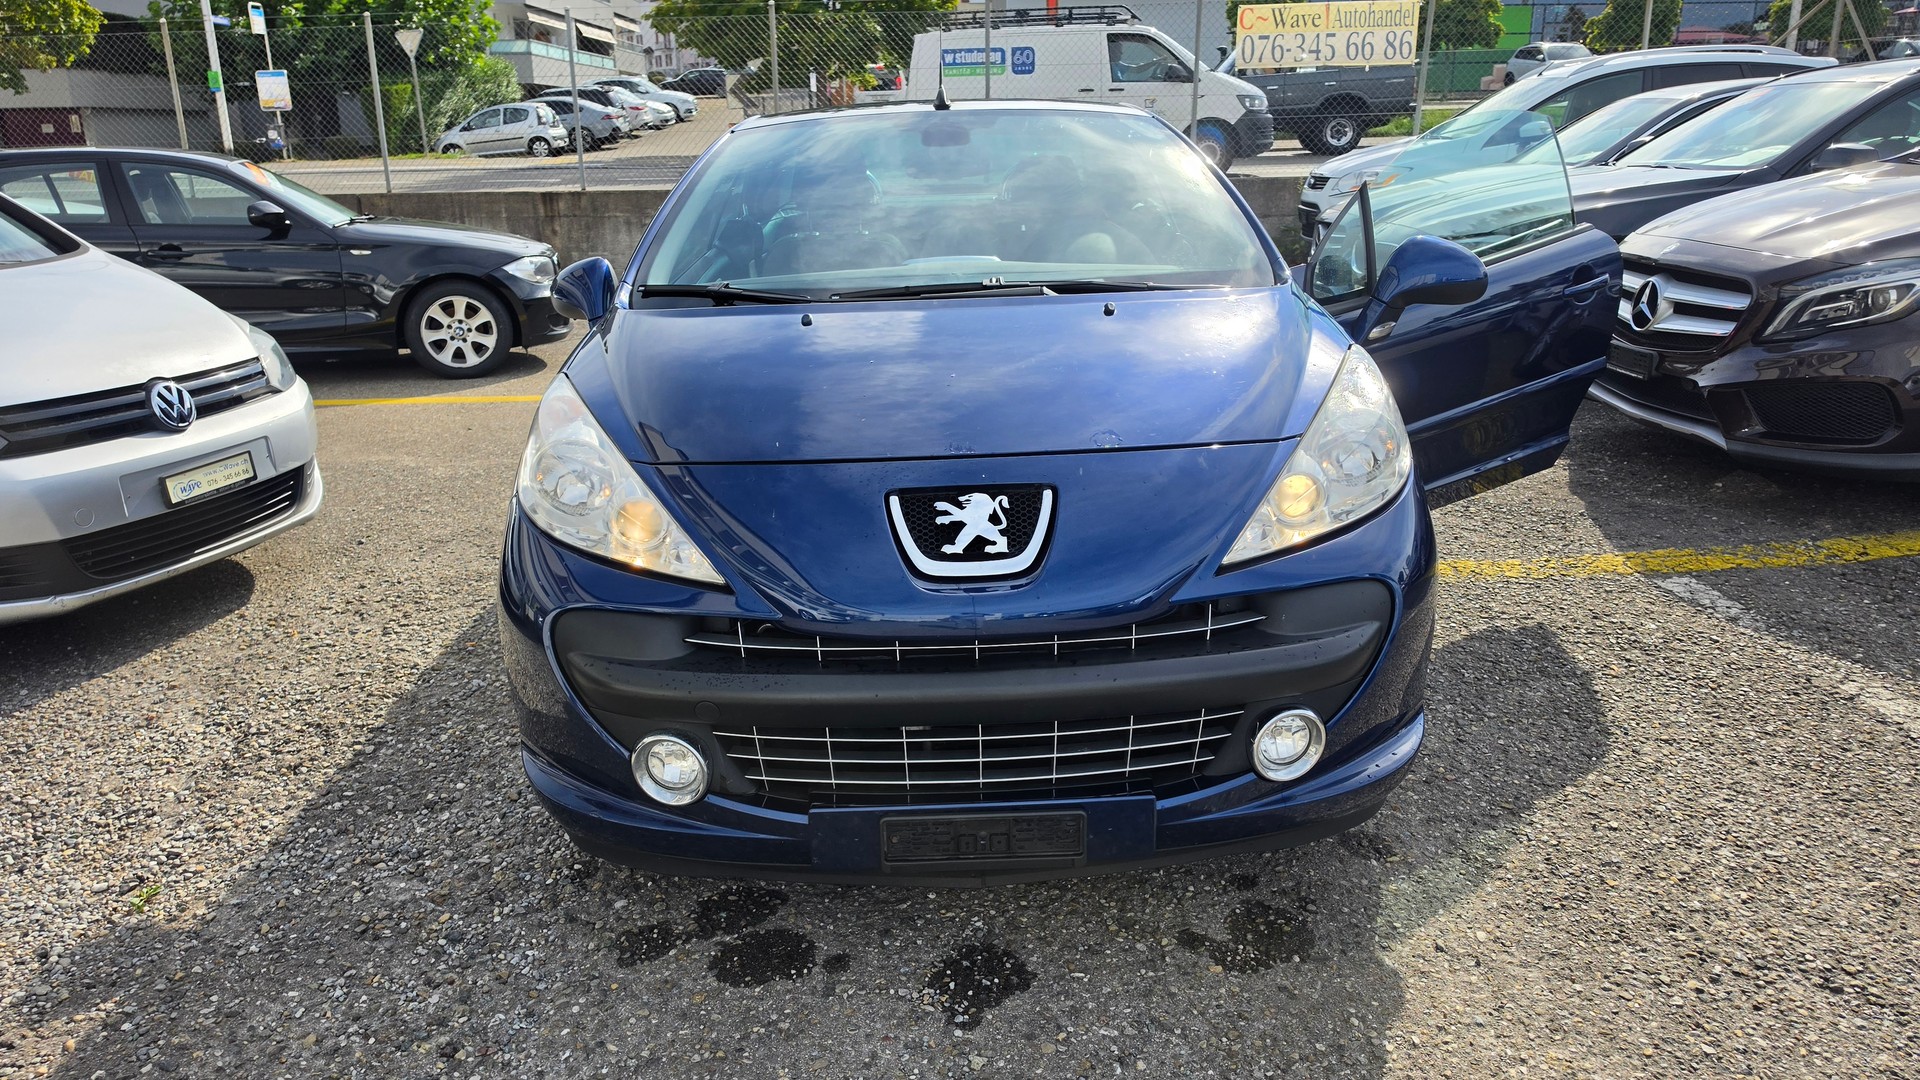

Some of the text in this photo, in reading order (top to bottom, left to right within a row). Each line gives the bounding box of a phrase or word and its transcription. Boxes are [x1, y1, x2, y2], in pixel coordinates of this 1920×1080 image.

[1331, 2, 1416, 29] Autohandel
[1013, 49, 1034, 64] 60
[1241, 30, 1413, 64] 076-345 66 86
[206, 478, 218, 487] 076
[223, 473, 233, 482] 345
